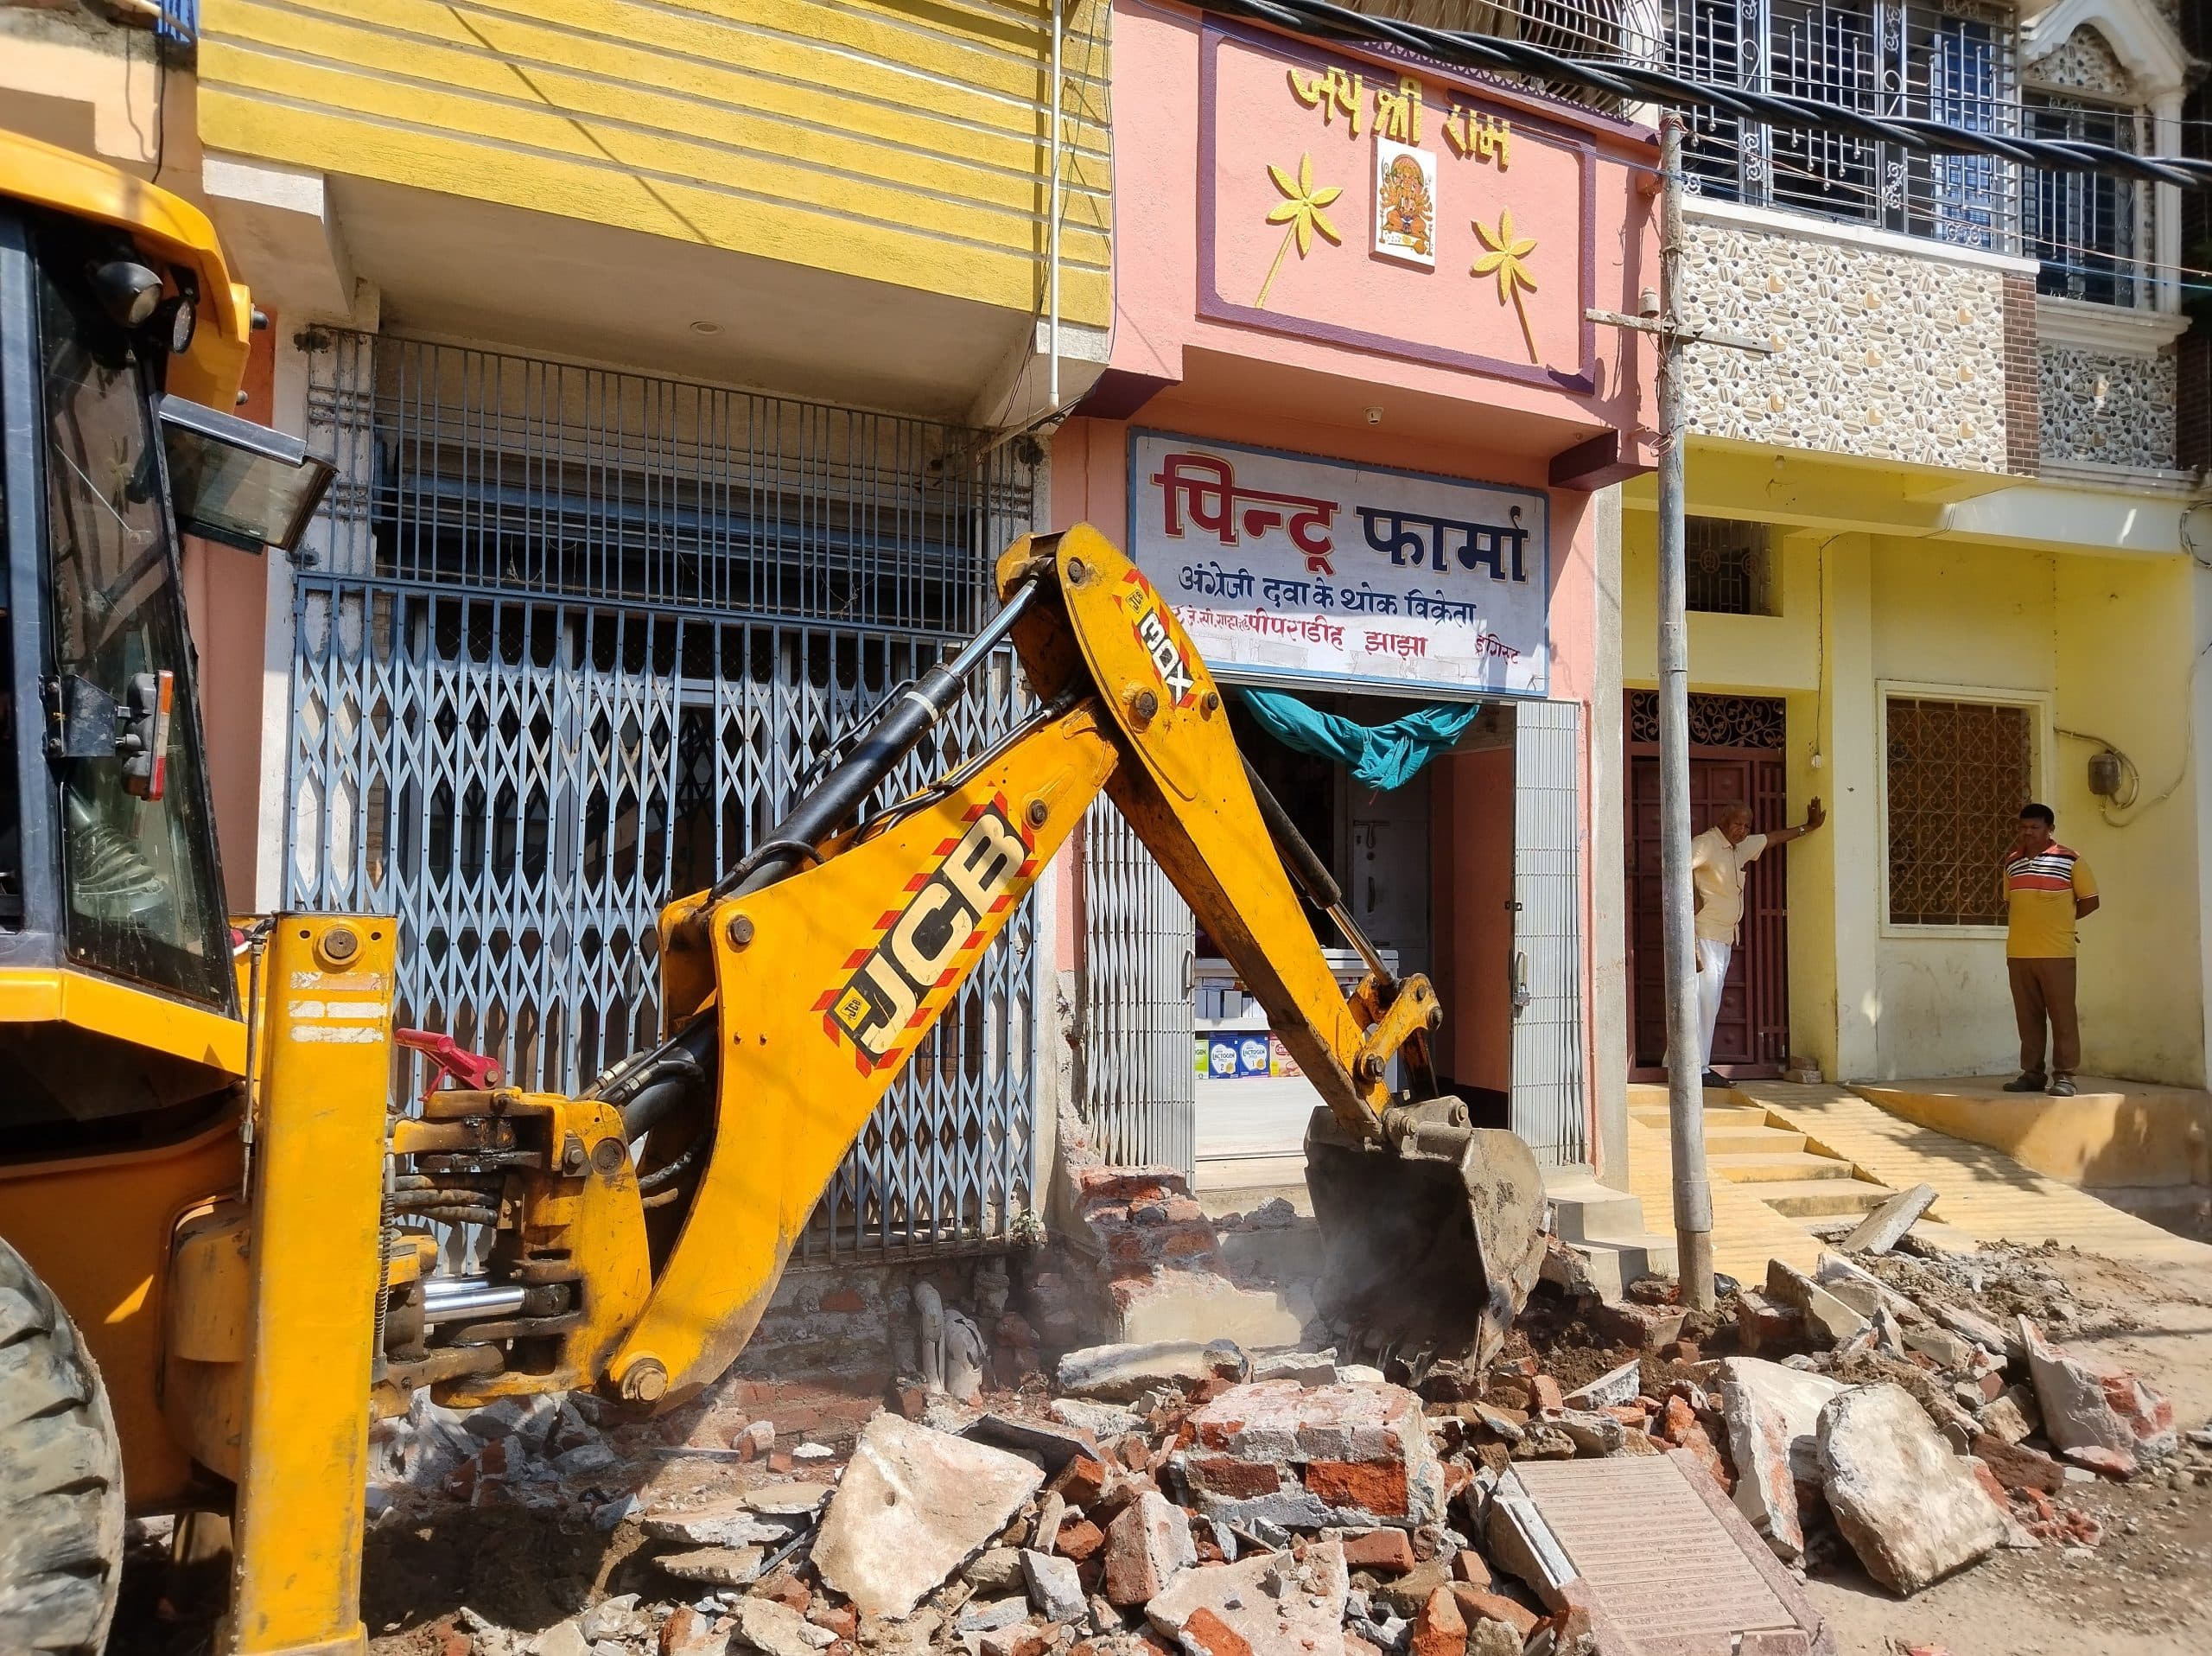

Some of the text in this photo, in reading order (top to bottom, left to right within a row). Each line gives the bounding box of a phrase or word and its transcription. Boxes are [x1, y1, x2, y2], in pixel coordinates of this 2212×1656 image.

[1287, 66, 1363, 134] जय
[1444, 104, 1510, 169] राम
[1150, 450, 1531, 583] पिन्टू फार्मा
[1128, 591, 1144, 611] JCB
[1178, 560, 1478, 627] अंग्रेजी दवा के थोक विक्रेता
[1140, 612, 1195, 706] 3DX
[1363, 631, 1428, 660] झाझा
[860, 813, 1025, 1054] JCB
[844, 998, 861, 1018] JCB
